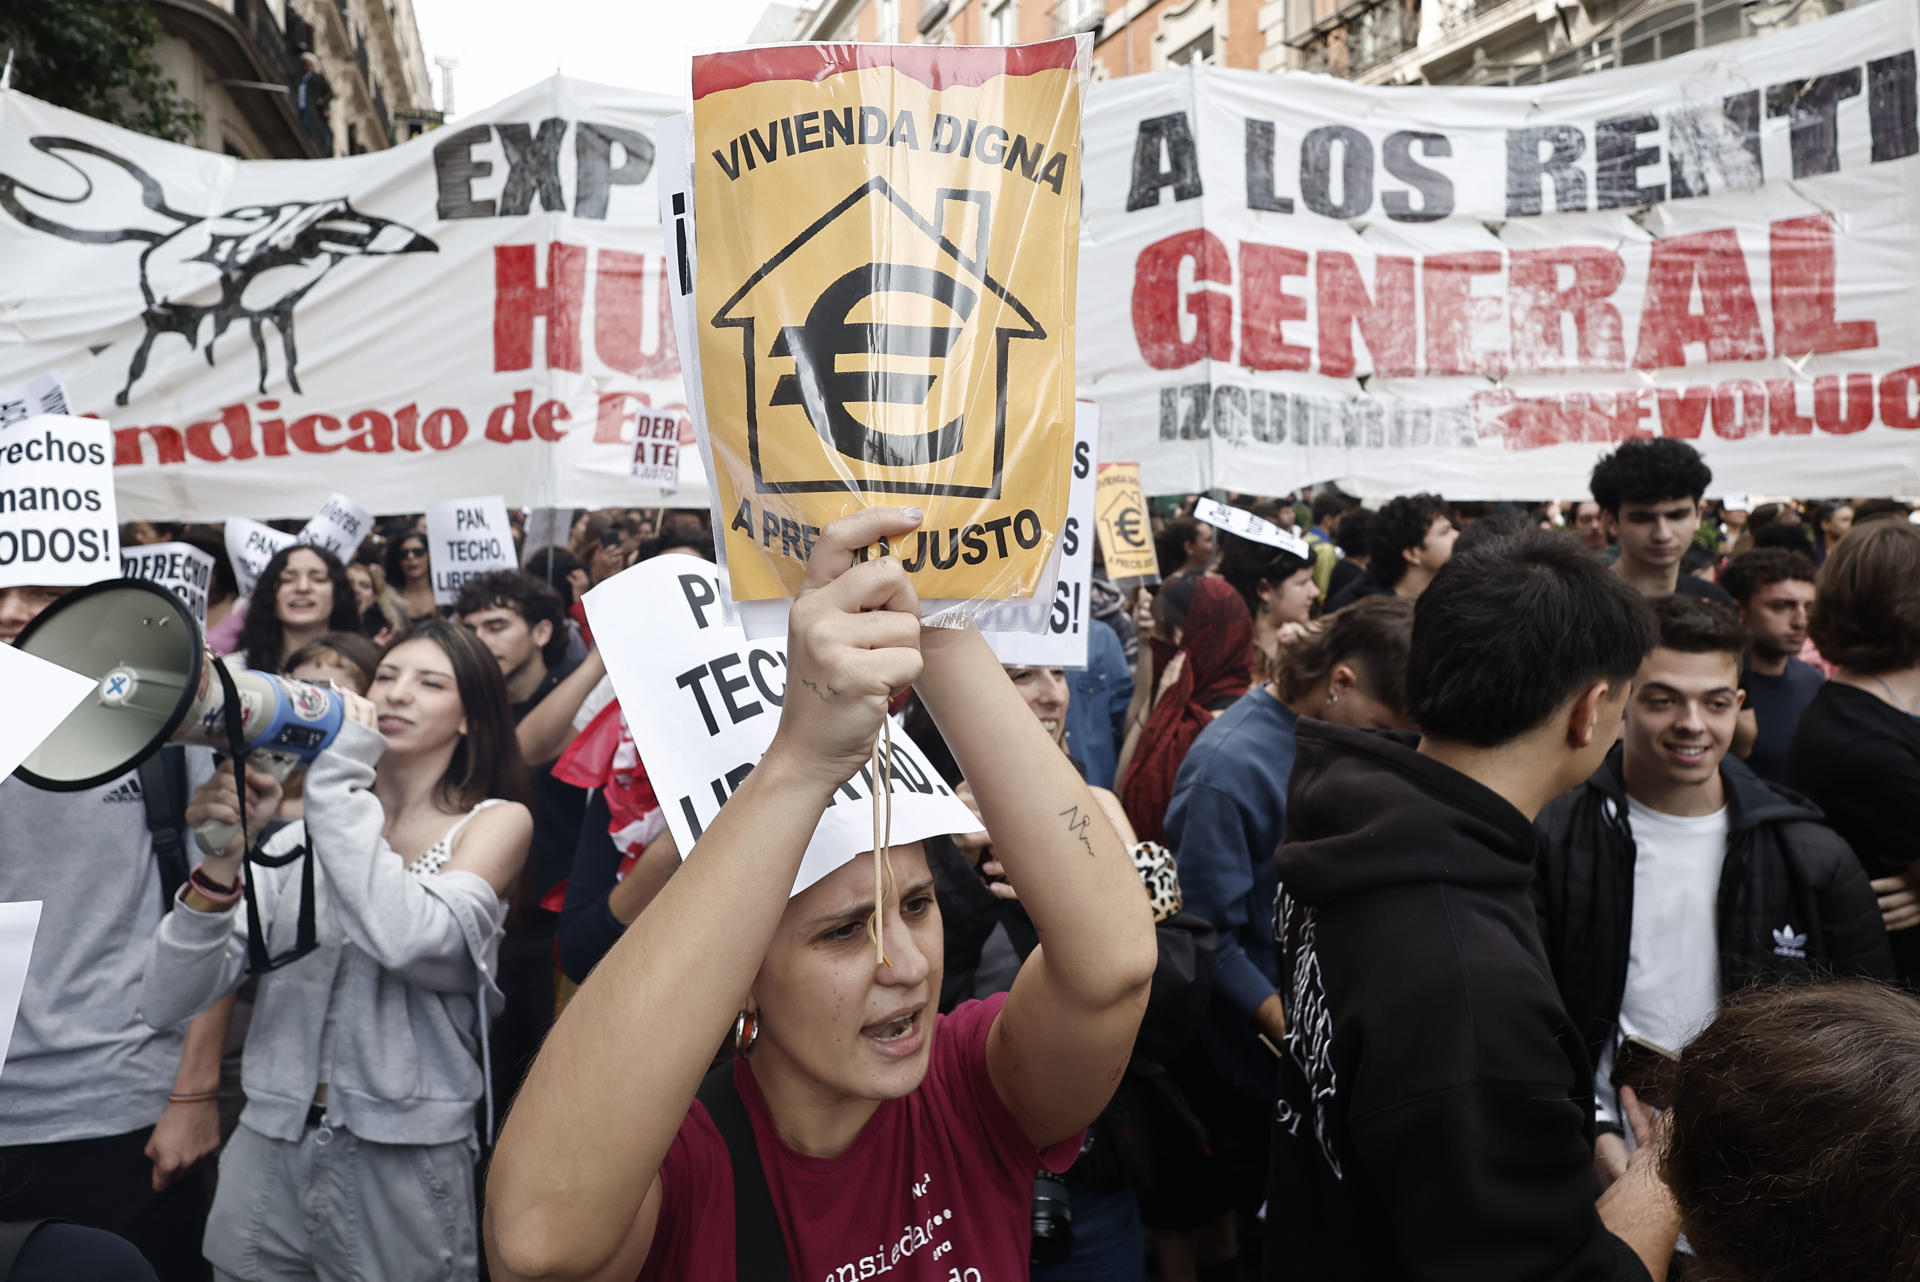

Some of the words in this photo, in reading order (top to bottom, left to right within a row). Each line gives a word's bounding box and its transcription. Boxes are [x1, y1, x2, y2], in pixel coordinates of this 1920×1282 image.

[712, 106, 919, 182] VIVIENDA
[931, 112, 1067, 196] DIGNA
[1126, 111, 1204, 212] A
[1244, 117, 1455, 222] LOS
[1131, 211, 1879, 379] GENERAL
[112, 399, 468, 466] ndicato
[484, 389, 571, 444] de
[637, 415, 681, 441] DER
[651, 443, 679, 468] TE
[446, 537, 506, 561] TECHO,
[731, 497, 755, 540] A
[902, 508, 1042, 574] JUSTO
[675, 648, 789, 737] TEC
